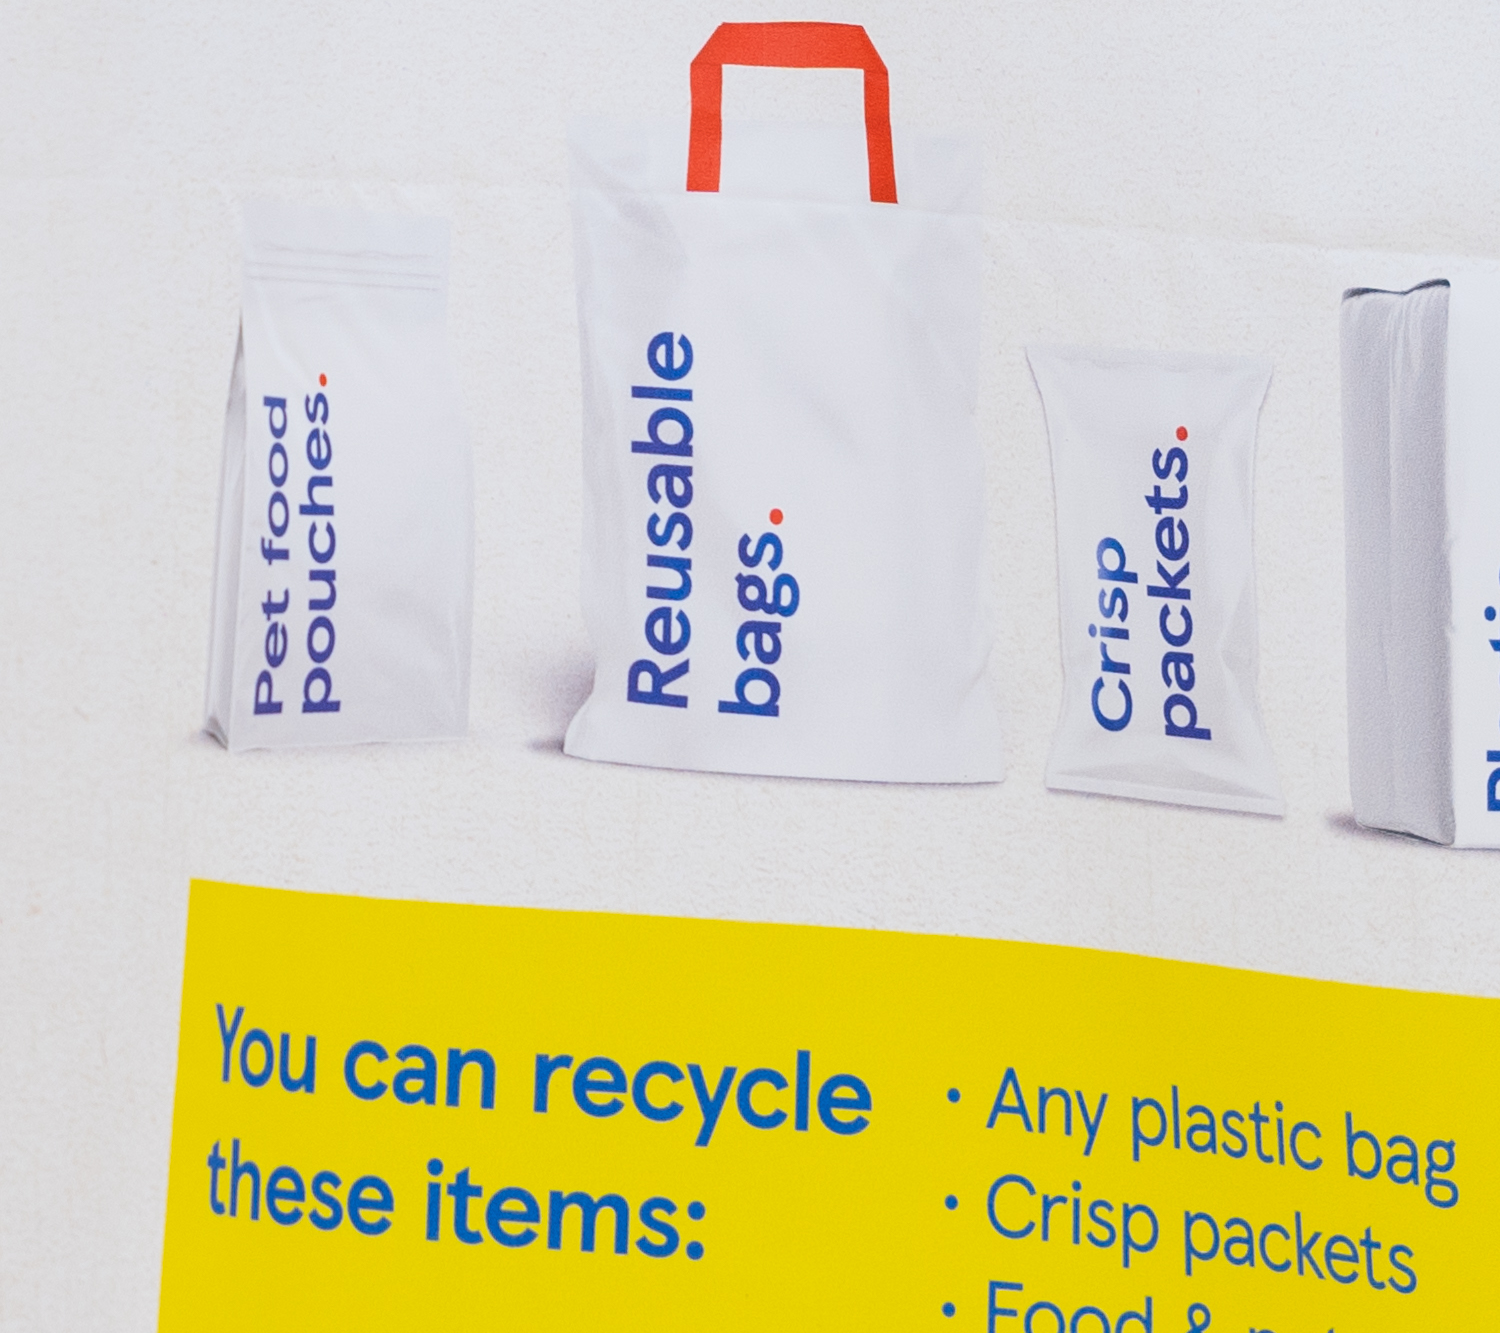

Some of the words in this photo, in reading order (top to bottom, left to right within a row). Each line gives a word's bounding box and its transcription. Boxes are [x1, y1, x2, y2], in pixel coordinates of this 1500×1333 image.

[259, 395, 291, 566] food
[298, 372, 341, 714] pouches.
[625, 331, 696, 709] Reusable
[253, 588, 291, 715] Pet
[717, 507, 802, 719] bags.
[1088, 536, 1139, 733] Crisp
[1145, 425, 1213, 741] packets.
[215, 1003, 318, 1094] You
[343, 1039, 496, 1110] can
[533, 1049, 874, 1148] recycle
[986, 1066, 1110, 1157] Any
[1131, 1084, 1323, 1171] plastic
[1344, 1111, 1460, 1209] bag
[206, 1138, 395, 1237] these
[425, 1157, 706, 1261] items:
[986, 1173, 1161, 1269] Crisp
[1184, 1202, 1419, 1294] packets
